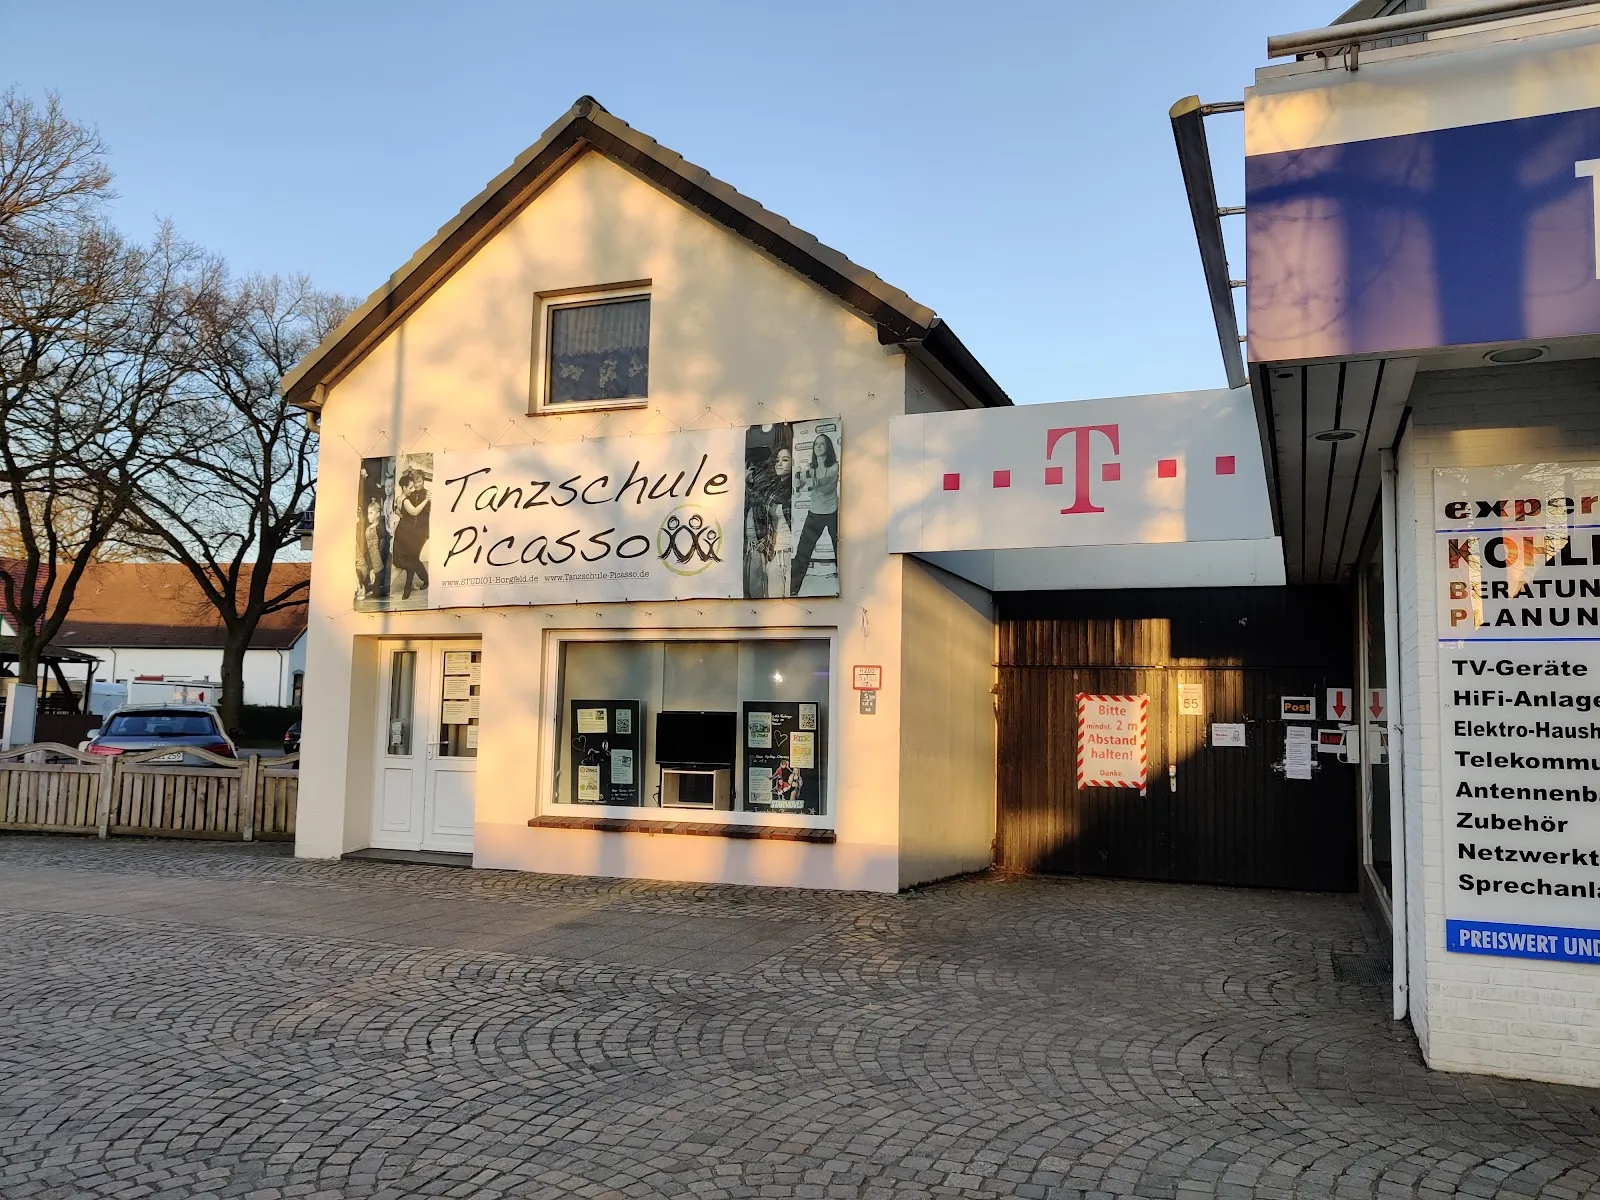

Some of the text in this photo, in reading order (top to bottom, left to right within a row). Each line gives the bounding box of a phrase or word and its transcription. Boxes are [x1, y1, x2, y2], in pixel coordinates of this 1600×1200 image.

[444, 453, 731, 513] Tanzschule
[443, 525, 651, 568] Picasso
[544, 570, 650, 582] www.Tanzschule-Picasso.de
[1451, 659, 1589, 677] TV-Geräte
[1098, 704, 1127, 716] Bitte
[1183, 698, 1199, 709] 55
[1284, 702, 1312, 712] Post
[1086, 720, 1138, 731] mindst. 2 m
[1454, 720, 1600, 739] Elektro-Haush
[1087, 733, 1137, 746] Abstand
[1091, 747, 1133, 761] halten!
[1100, 769, 1125, 778] Danke.
[1455, 781, 1600, 803] Antennenb
[1456, 811, 1569, 833] Zubehör
[1458, 842, 1600, 867] Netzwerkt
[1458, 873, 1600, 898] Sprechanl
[1459, 929, 1558, 954] PREISWERT
